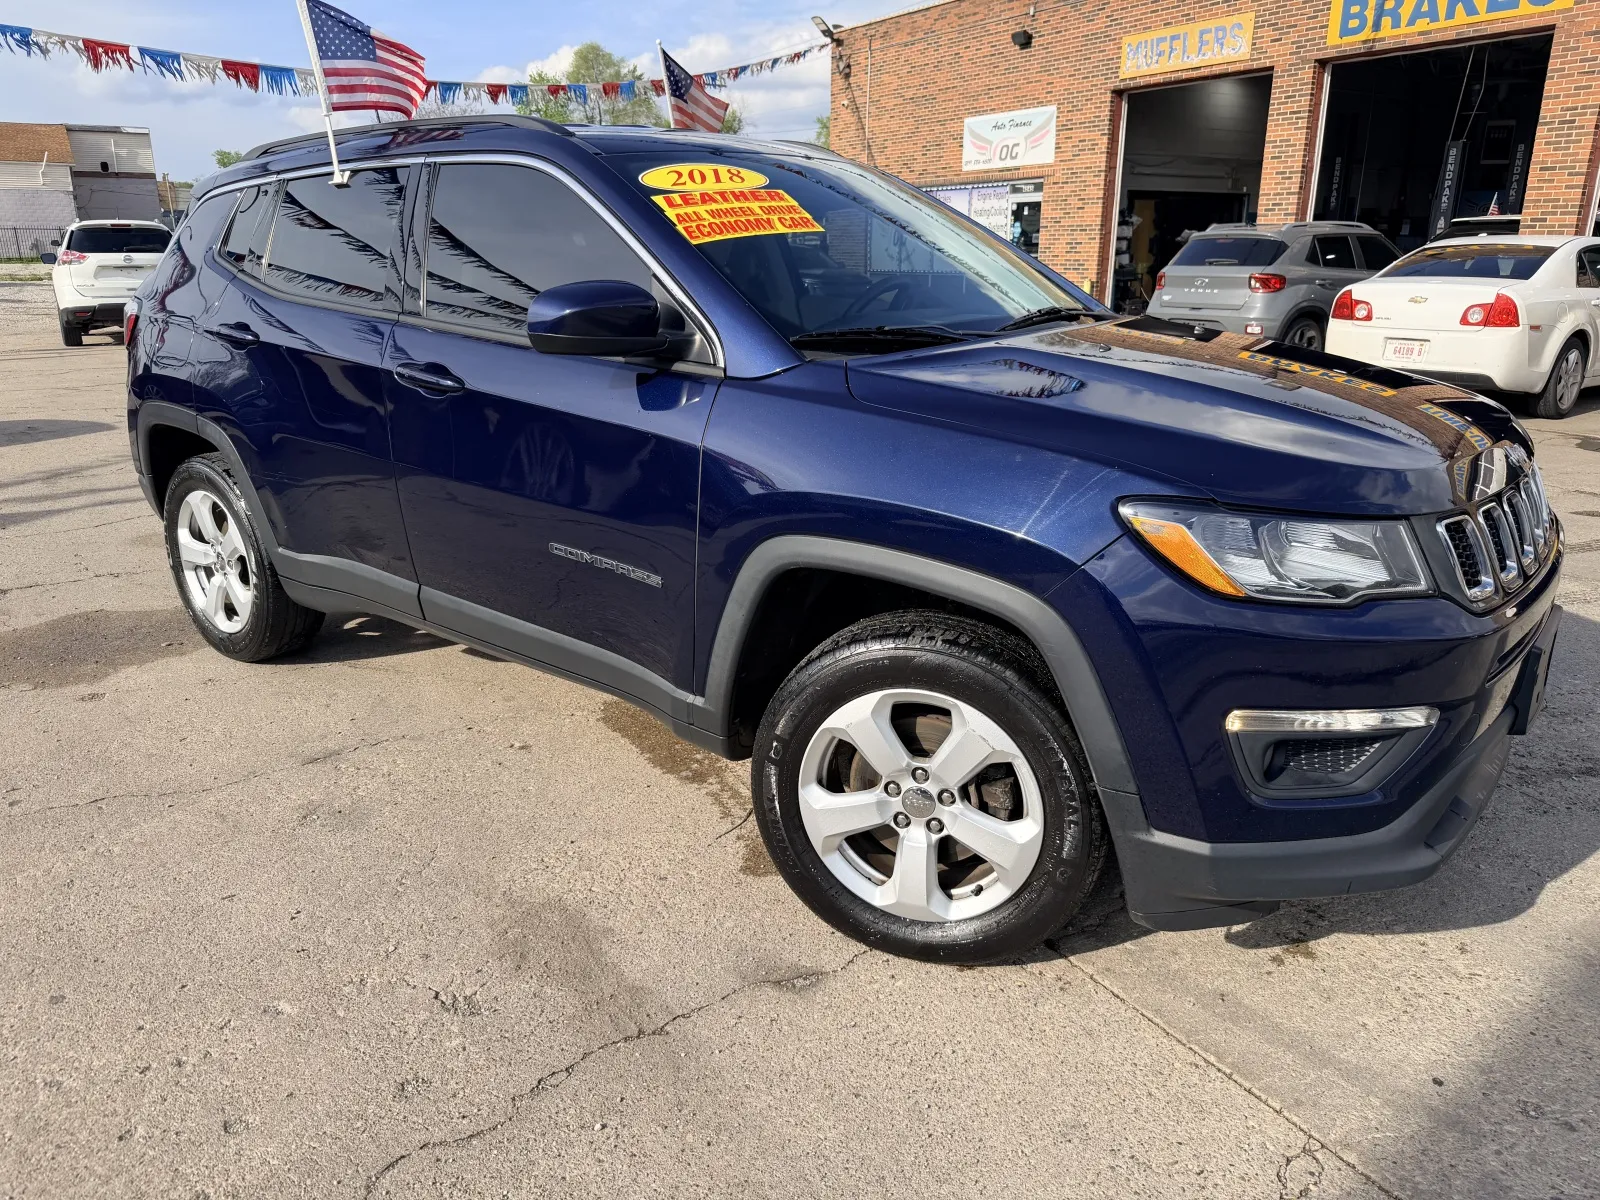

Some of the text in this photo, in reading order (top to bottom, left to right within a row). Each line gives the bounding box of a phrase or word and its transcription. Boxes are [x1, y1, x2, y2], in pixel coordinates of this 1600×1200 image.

[1339, 0, 1555, 38] BRAK
[1126, 22, 1245, 71] MUFFLERS
[991, 119, 1032, 132] Auto Finance
[999, 143, 1020, 161] OG
[666, 168, 746, 187] 2018
[1441, 147, 1457, 203] BENDPAK
[1509, 144, 1525, 196] BENDPAK
[663, 190, 788, 209] LEATHER
[977, 190, 992, 204] Engine
[675, 203, 802, 226] ALL WHEEL DRIVE
[683, 215, 817, 241] ECONOMY CAR
